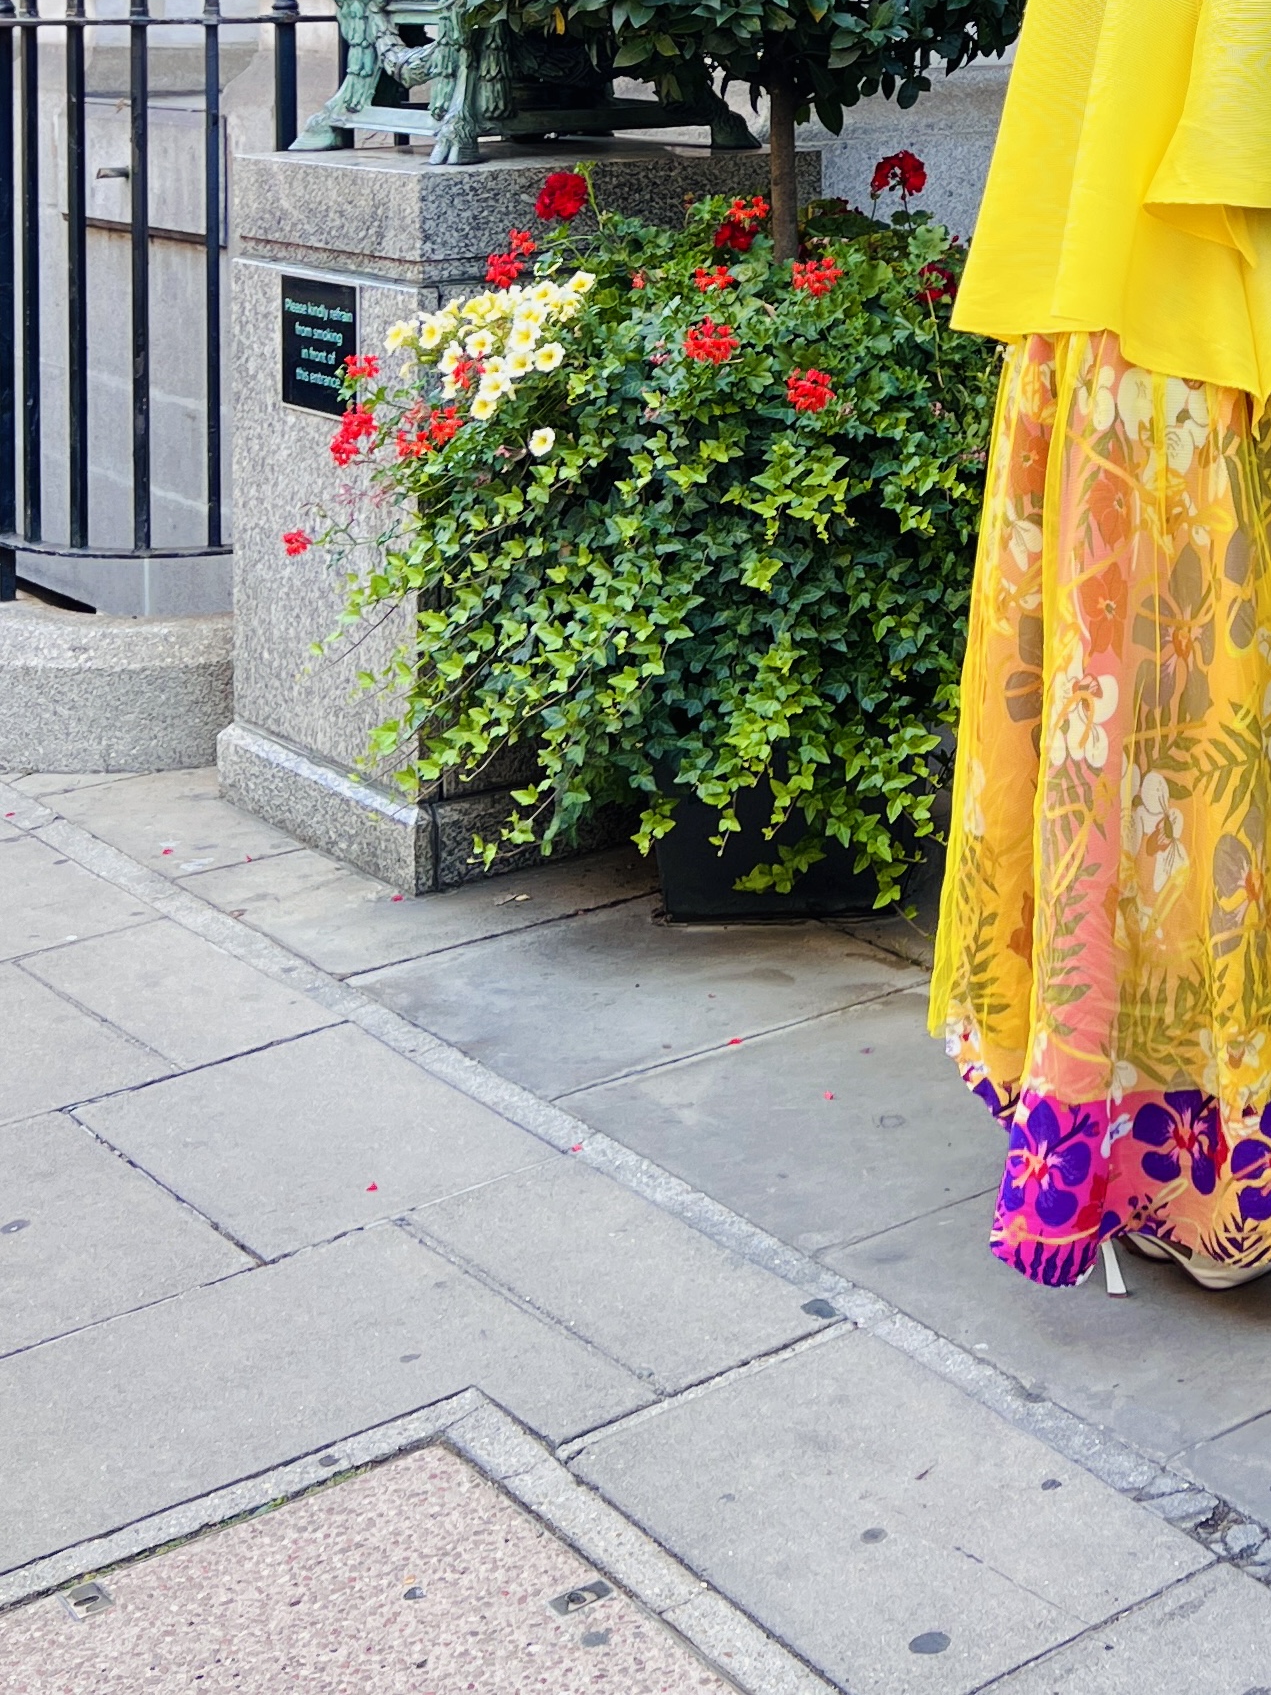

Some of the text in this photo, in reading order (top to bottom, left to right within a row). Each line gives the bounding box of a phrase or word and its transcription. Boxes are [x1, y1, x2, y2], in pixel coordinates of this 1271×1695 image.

[285, 298, 353, 322] Please kindly refrain
[295, 321, 342, 346] from smoking
[301, 345, 336, 364] in front of
[296, 367, 309, 381] this
